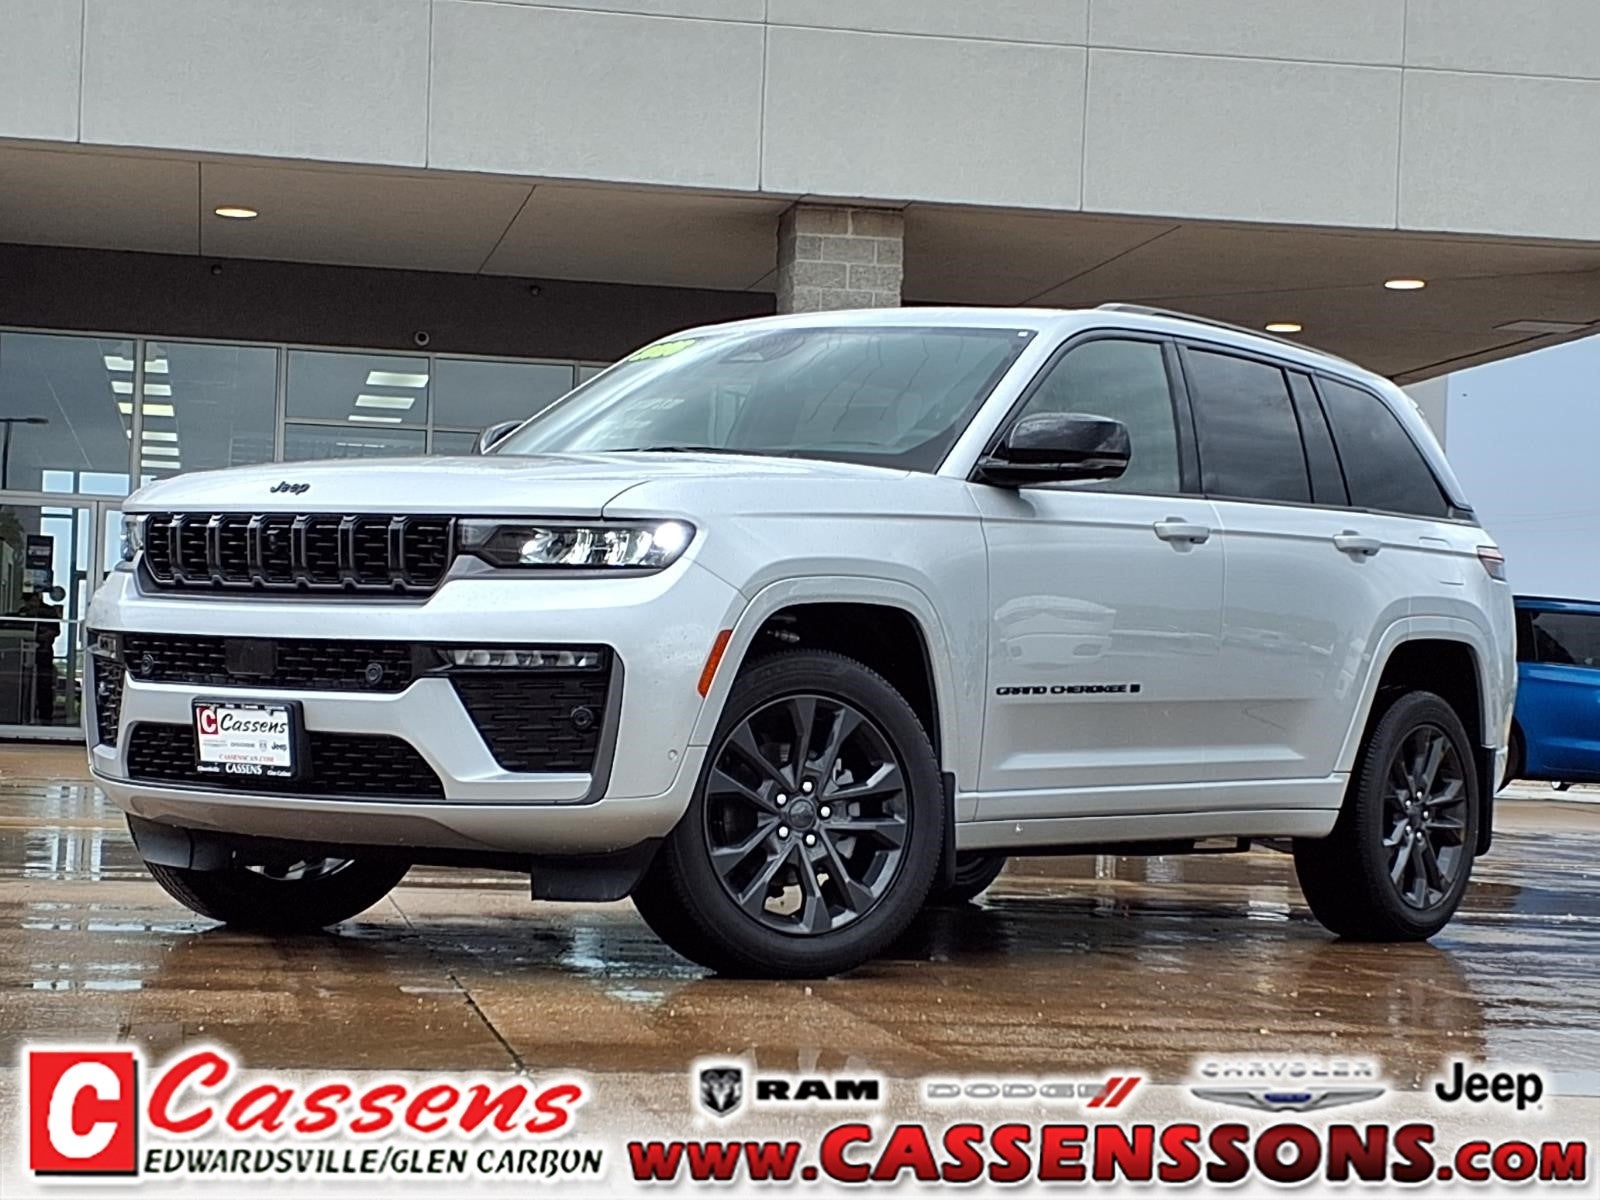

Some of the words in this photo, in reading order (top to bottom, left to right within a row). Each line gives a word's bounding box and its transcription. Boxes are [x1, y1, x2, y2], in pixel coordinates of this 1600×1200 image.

[270, 481, 310, 495] Jeep
[996, 686, 1047, 695] GRAND
[1050, 685, 1126, 694] CHEROKEE
[220, 713, 287, 734] Cassens
[225, 763, 262, 775] CASSENS
